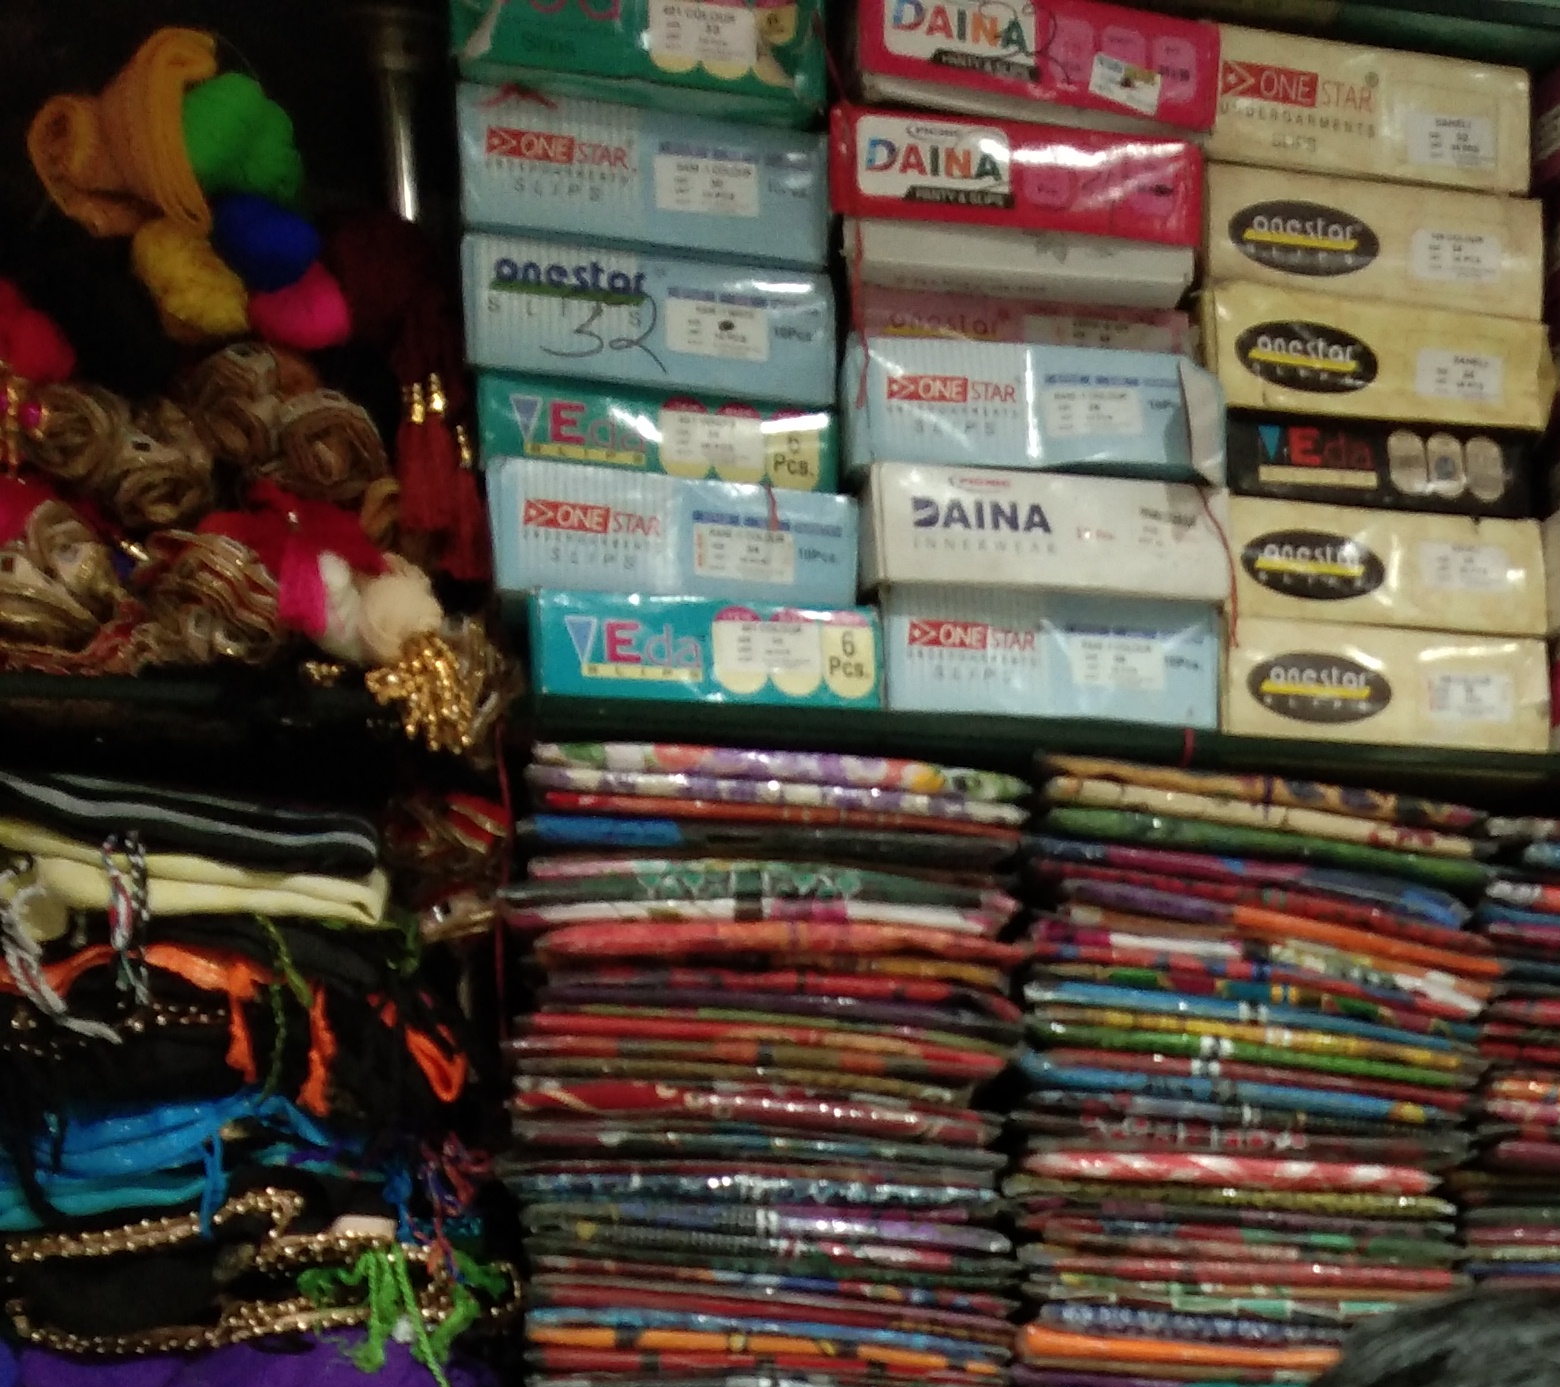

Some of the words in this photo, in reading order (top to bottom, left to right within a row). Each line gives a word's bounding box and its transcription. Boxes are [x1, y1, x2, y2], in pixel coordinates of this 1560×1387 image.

[891, 0, 1028, 54] DAINA
[1259, 70, 1312, 100] ONE
[1321, 82, 1374, 113] STAR
[521, 133, 573, 161] ONE
[575, 143, 629, 170] STAR
[866, 138, 1003, 181] DAINA
[1253, 214, 1356, 241] onestar
[494, 258, 646, 292] onestar
[1256, 335, 1358, 362] onestar
[918, 380, 964, 402] ONE
[970, 381, 1017, 404] STAR
[556, 506, 604, 531] ONE
[612, 509, 661, 536] STAR
[912, 497, 1052, 535] DAINA
[840, 630, 856, 659] 6
[938, 625, 985, 650] ONE
[988, 627, 1036, 651] STAR
[1270, 665, 1369, 690] onestar
